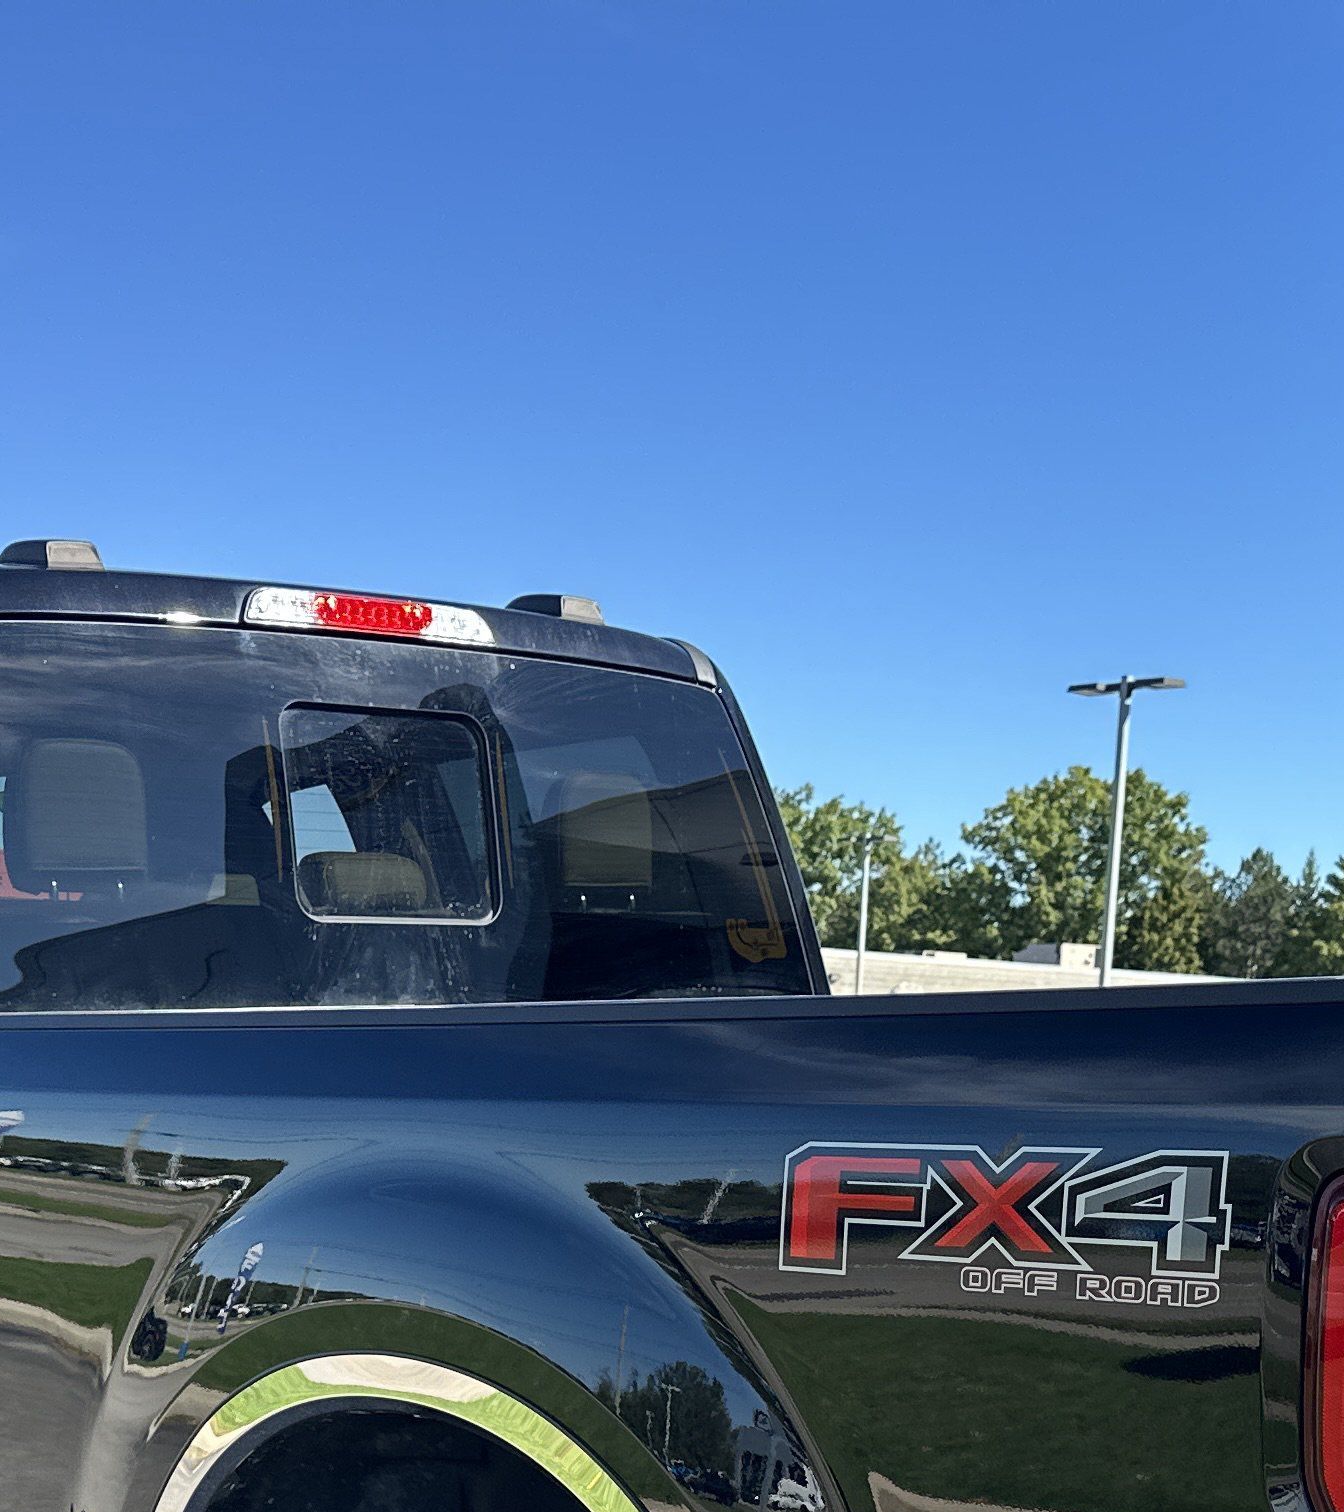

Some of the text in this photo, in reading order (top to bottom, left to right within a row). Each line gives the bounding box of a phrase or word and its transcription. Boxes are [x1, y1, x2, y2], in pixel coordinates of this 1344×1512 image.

[778, 1141, 1232, 1279] FX4
[960, 1266, 1220, 1308] OFF ROAD
